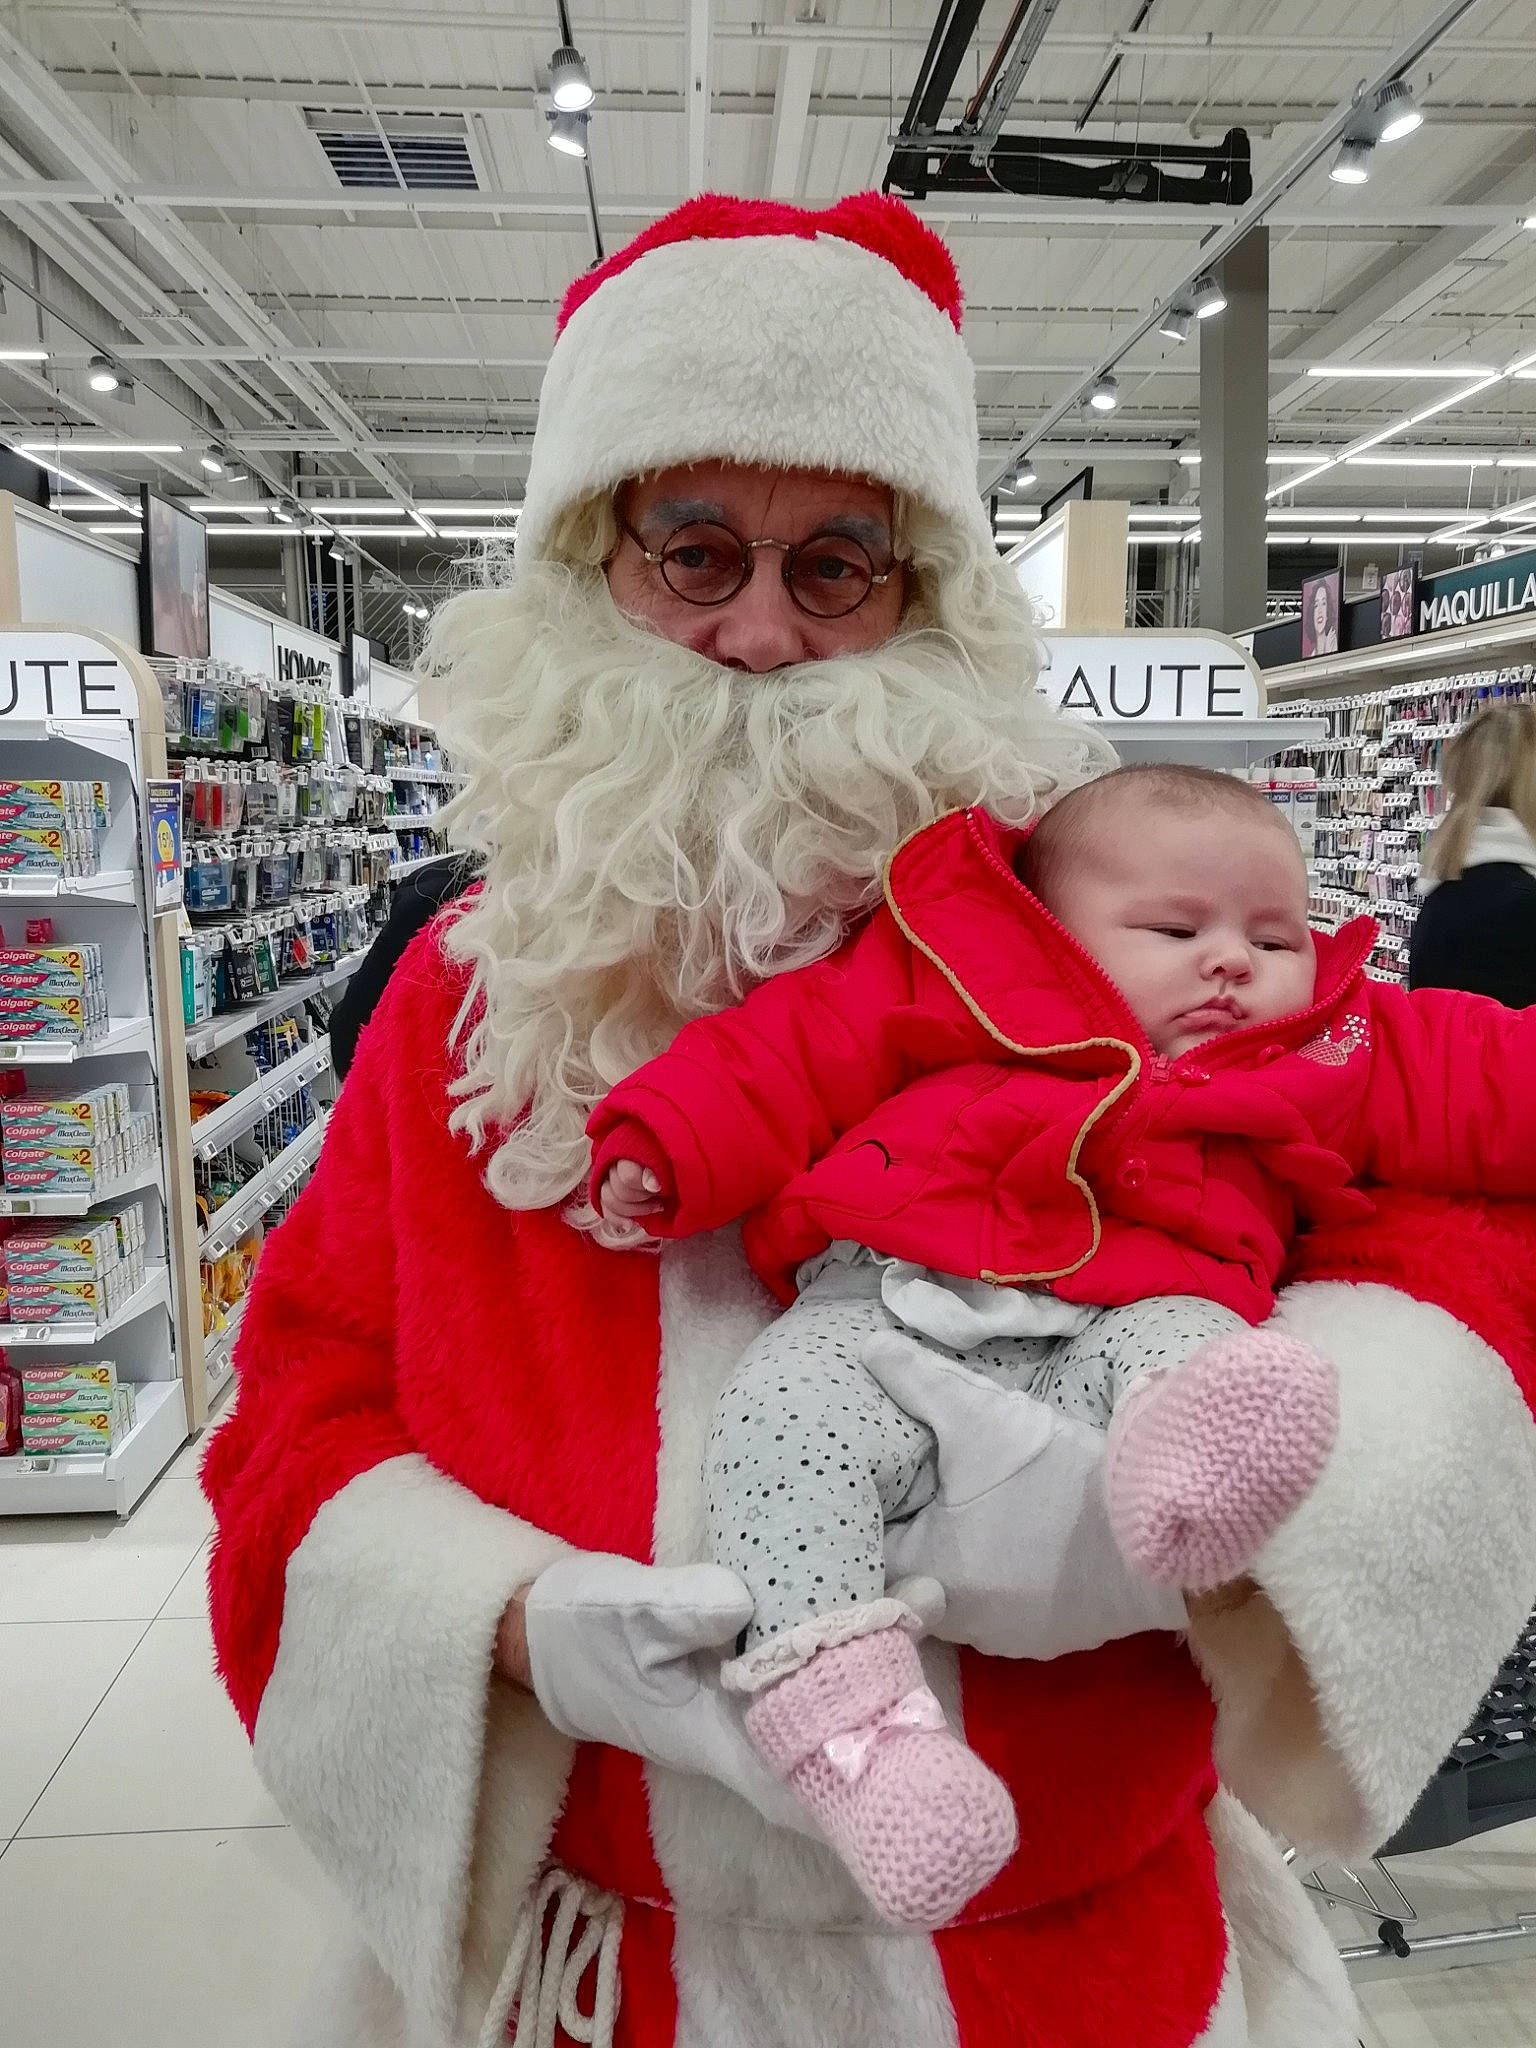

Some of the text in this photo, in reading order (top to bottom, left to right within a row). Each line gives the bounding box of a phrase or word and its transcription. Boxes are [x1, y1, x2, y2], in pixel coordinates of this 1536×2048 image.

[1420, 572, 1536, 632] MAQUILLA
[277, 645, 330, 686] HOMM
[1035, 664, 1246, 718] AUTE
[42, 782, 62, 800] x2
[40, 831, 61, 848] x2
[62, 952, 81, 969] x2
[0, 974, 39, 985] Colgate
[0, 999, 34, 1009] olgate
[60, 999, 80, 1014] x2
[0, 1022, 37, 1032] Colgate
[3, 1104, 45, 1113] Colgate
[72, 1103, 92, 1119] x2
[5, 1127, 47, 1136] Colgate
[5, 1150, 45, 1158] Colgate
[72, 1149, 92, 1165] x2
[7, 1172, 48, 1181] Colgate
[7, 1240, 48, 1250] Colgate
[73, 1238, 93, 1254] x2
[10, 1262, 50, 1272] Colgate
[10, 1284, 50, 1294] Colgate
[76, 1283, 96, 1299] x2
[13, 1306, 52, 1316] Colgate
[24, 1370, 64, 1380] Colgate
[91, 1368, 110, 1383] x2
[27, 1391, 67, 1401] Colgate
[24, 1416, 63, 1426] Colgate
[89, 1414, 108, 1430] x2
[26, 1437, 65, 1447] Colgate
